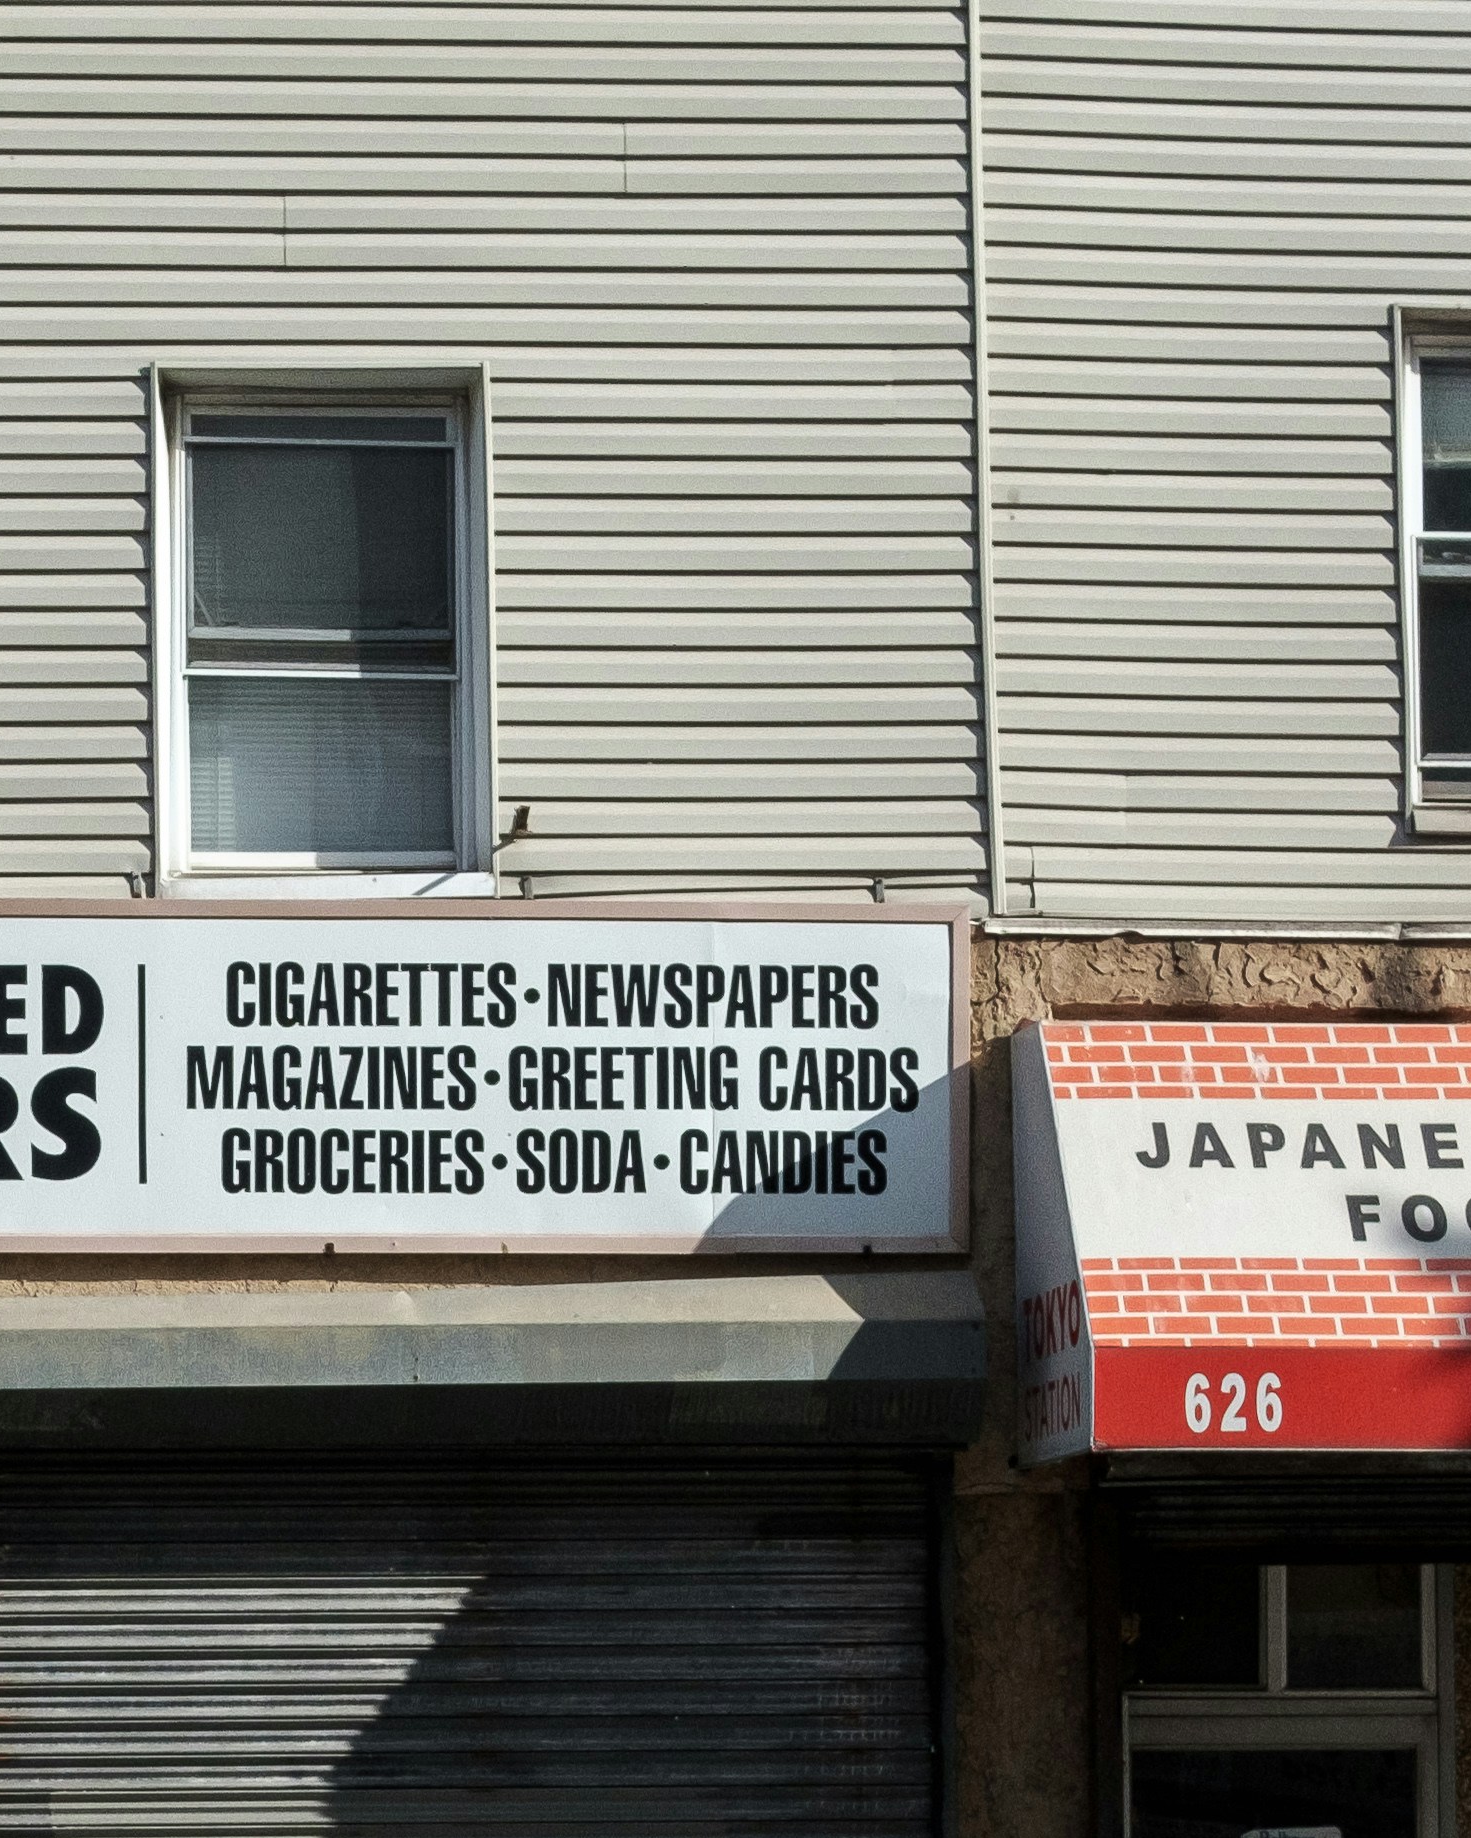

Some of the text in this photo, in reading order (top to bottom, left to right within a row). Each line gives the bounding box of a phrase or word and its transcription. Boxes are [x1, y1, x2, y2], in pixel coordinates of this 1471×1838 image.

[758, 1047, 920, 1114] CARDS
[1022, 1279, 1081, 1363] TOKYO
[1025, 1371, 1081, 1442] STATION
[1184, 1372, 1284, 1433] 626
